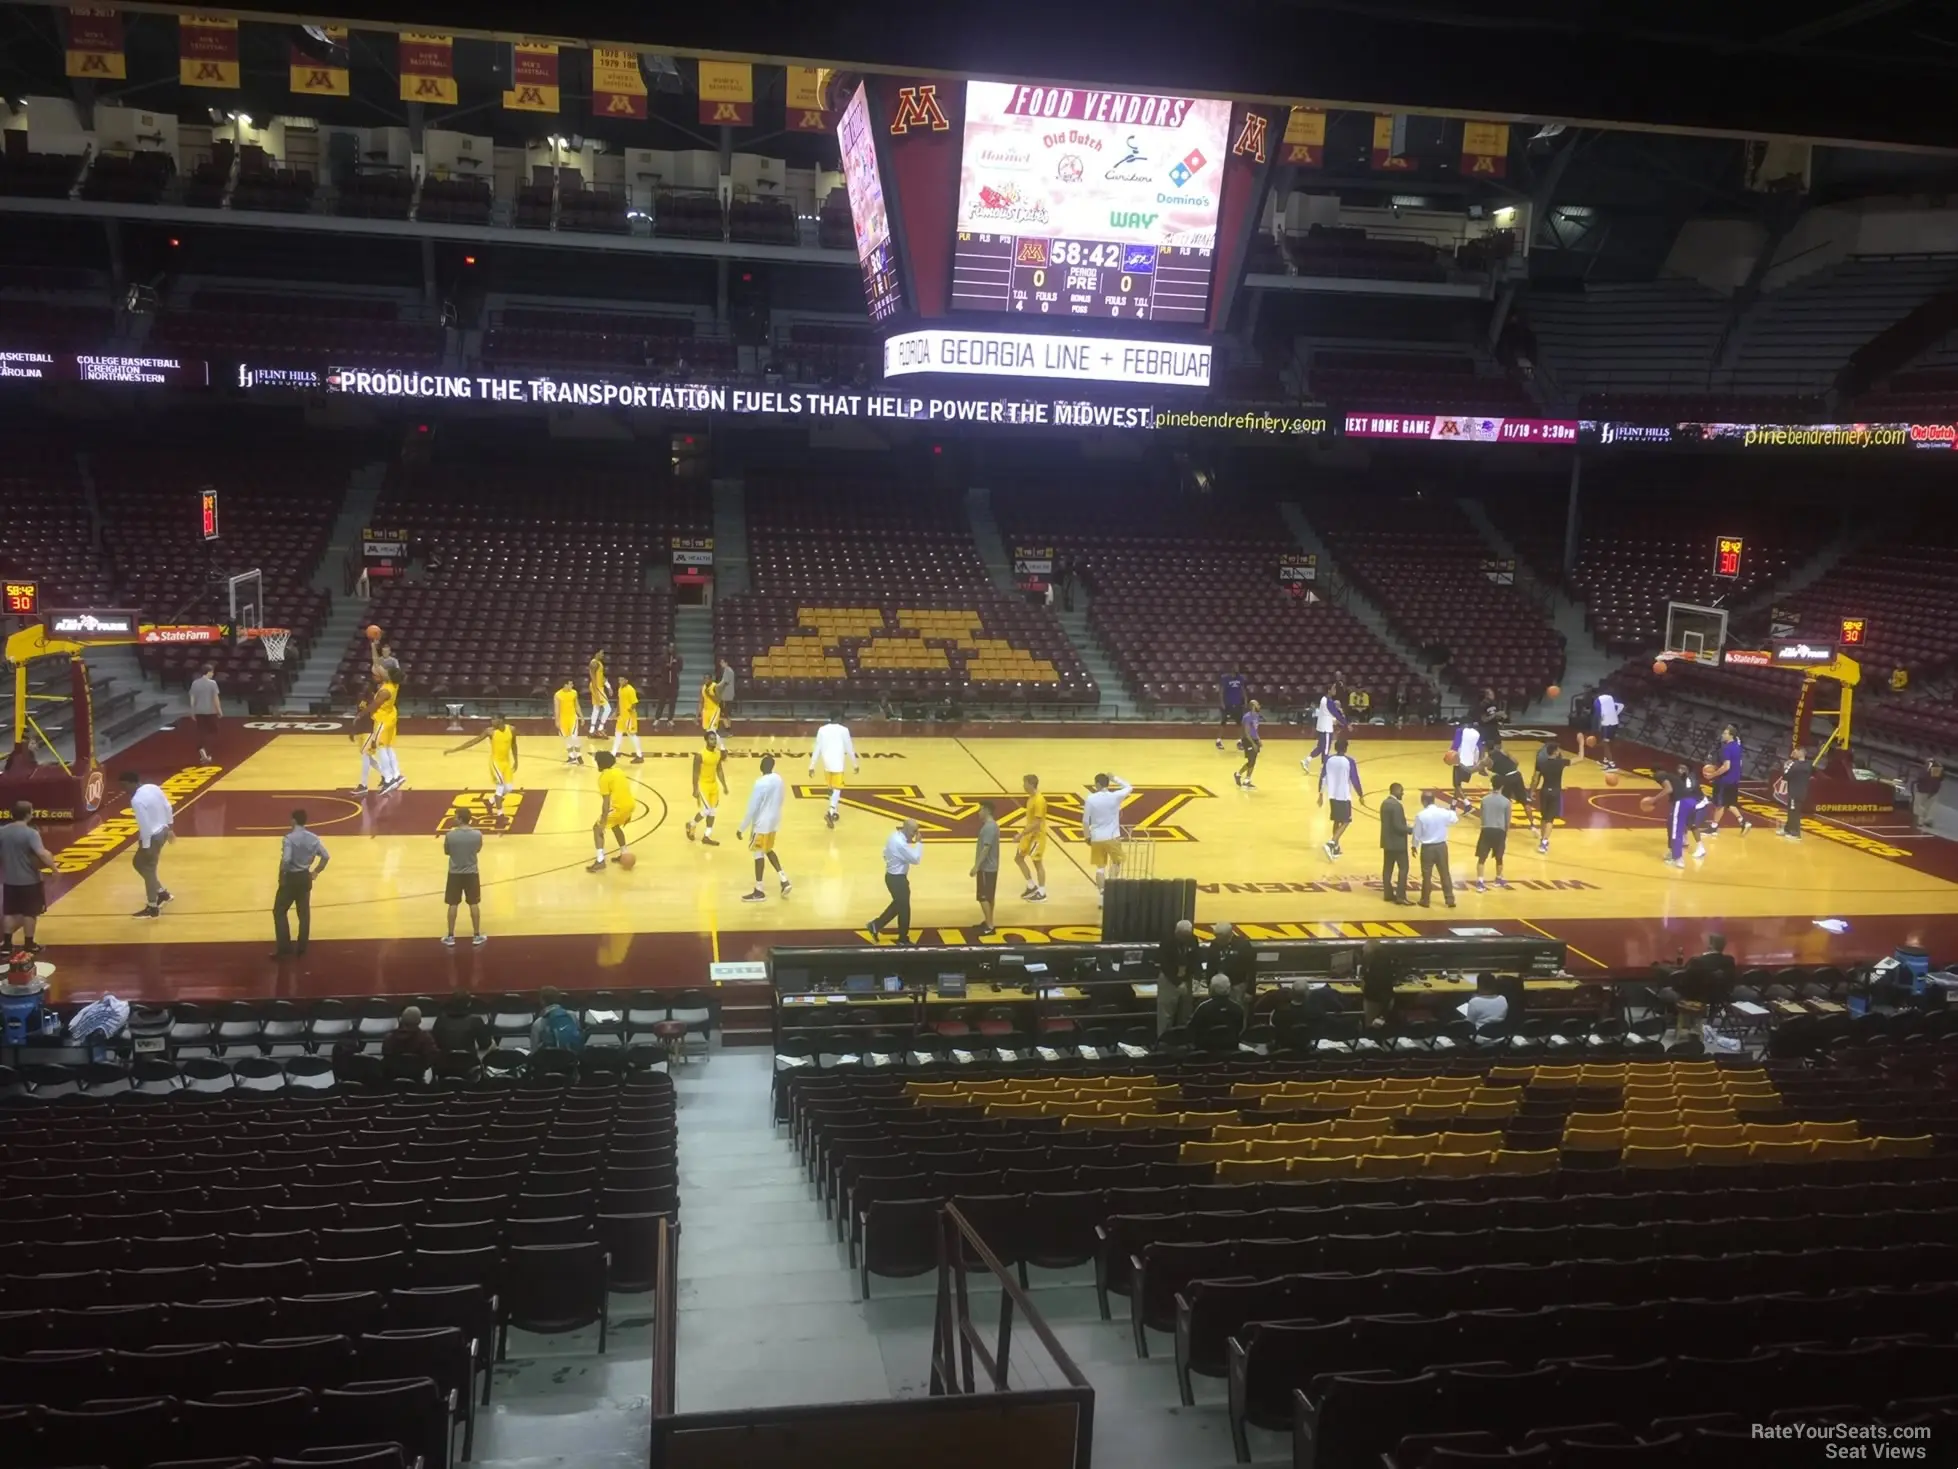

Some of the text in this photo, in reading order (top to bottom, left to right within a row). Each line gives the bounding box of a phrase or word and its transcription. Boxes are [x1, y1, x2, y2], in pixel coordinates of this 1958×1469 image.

[81, 55, 112, 73] M
[195, 63, 225, 81] M
[305, 71, 334, 89] M
[415, 79, 444, 97] M
[517, 87, 545, 105] M
[607, 95, 635, 113] M
[713, 103, 742, 121] M
[891, 85, 949, 135] M
[1015, 87, 1185, 127] FOOD VENDORS
[800, 111, 826, 129] M
[1043, 130, 1103, 152] Old Dutch
[1233, 112, 1267, 164] M
[1288, 145, 1312, 162] M
[1157, 193, 1210, 207] Domino's
[1051, 240, 1120, 268] 58:42
[1033, 270, 1045, 287] 0
[1070, 267, 1097, 277] PERIOD
[1067, 276, 1098, 290] PRE
[1120, 275, 1132, 292] 0
[1035, 292, 1058, 302] FOULS
[1105, 295, 1127, 306] FOULS
[1016, 300, 1023, 312] 4
[1041, 301, 1049, 313] 0
[1111, 306, 1119, 317] 0
[1136, 307, 1144, 319] 4
[77, 355, 181, 369] COLLEGE BASKETBALL
[940, 338, 1035, 368] GEORGIA
[1045, 343, 1090, 371] LINE
[1123, 348, 1211, 379] FEBRUAR
[88, 364, 140, 374] CREIGHTON
[88, 371, 165, 383] NORTHWESTERN
[259, 369, 317, 381] FLINT HILLS
[340, 371, 472, 397] PRODUCING
[476, 377, 523, 401] THE
[528, 380, 725, 411] TRANSPORTATION
[733, 390, 802, 414] FUELS
[806, 394, 858, 416] THAT
[866, 396, 923, 419] HELP
[929, 400, 1002, 422] POWER
[1005, 402, 1048, 424] THE
[1156, 409, 1326, 435] pinebendrefinery.com
[1371, 419, 1399, 433] HOME
[1402, 420, 1430, 435] GAME
[1438, 421, 1460, 436] M
[1619, 427, 1670, 437] FLINT HILLS
[1744, 426, 1906, 449] pinebendrefinery.com
[6, 585, 34, 596] 58:42
[12, 597, 31, 610] 30
[1791, 682, 1809, 751] MINNESOT
[1815, 803, 1893, 813] GOPHERSPORTS.com
[1196, 881, 1352, 895] ARENA
